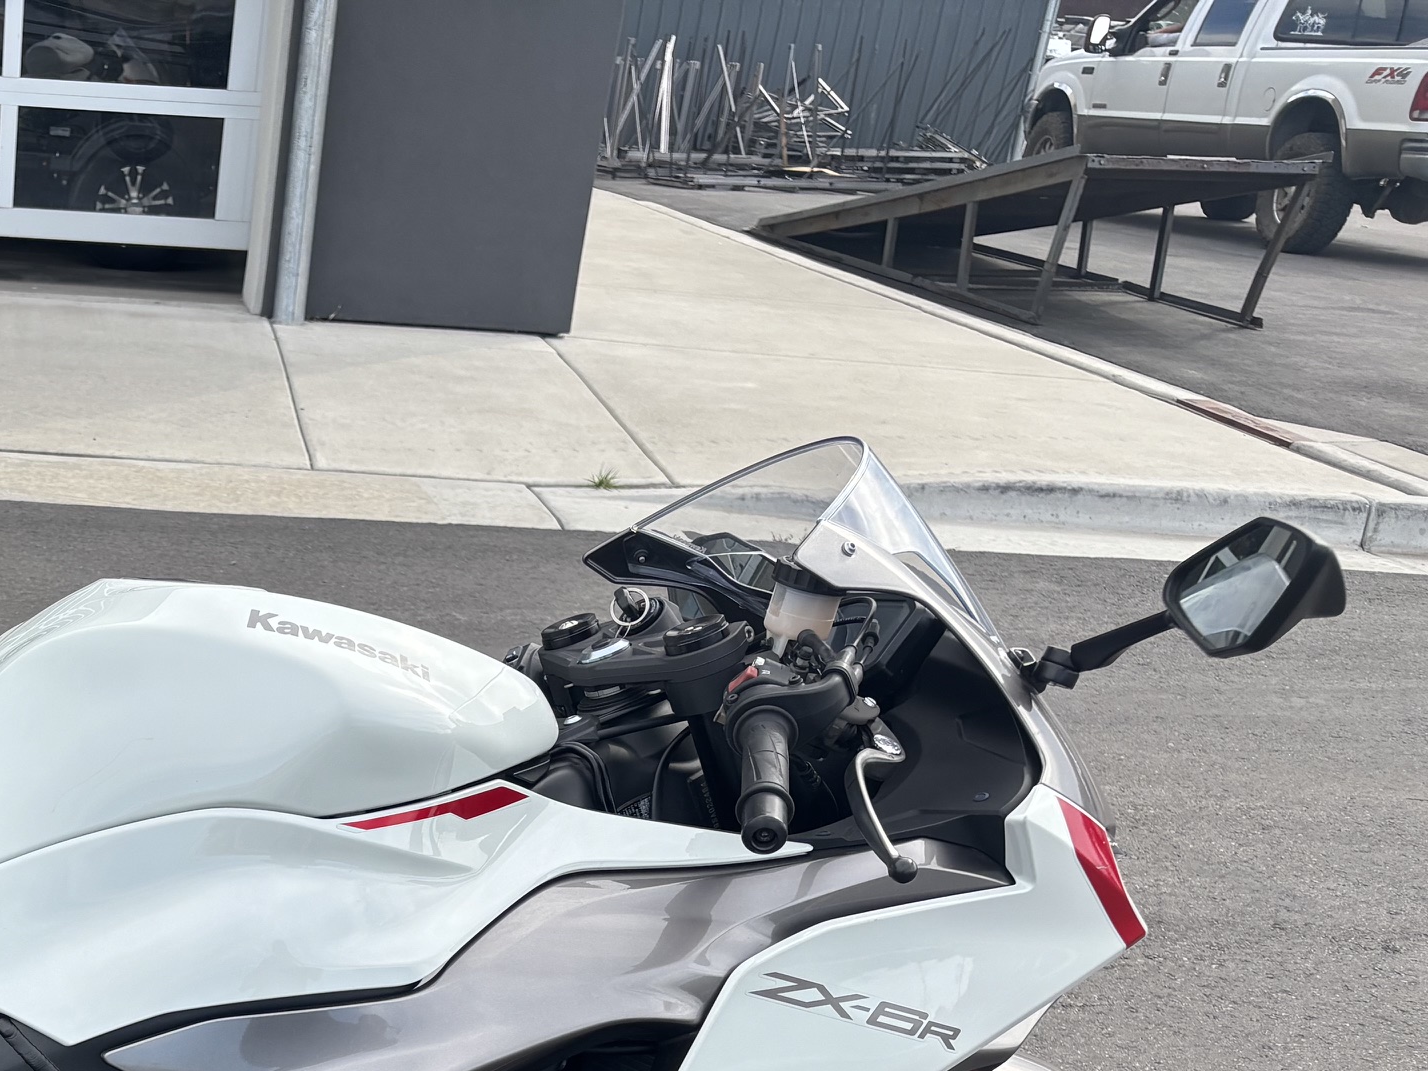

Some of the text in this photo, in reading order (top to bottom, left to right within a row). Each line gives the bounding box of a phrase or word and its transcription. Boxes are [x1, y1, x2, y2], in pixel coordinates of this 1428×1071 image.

[1368, 66, 1412, 80] FX4
[246, 608, 431, 683] Kawasaki
[747, 971, 962, 1051] ZX-6R
